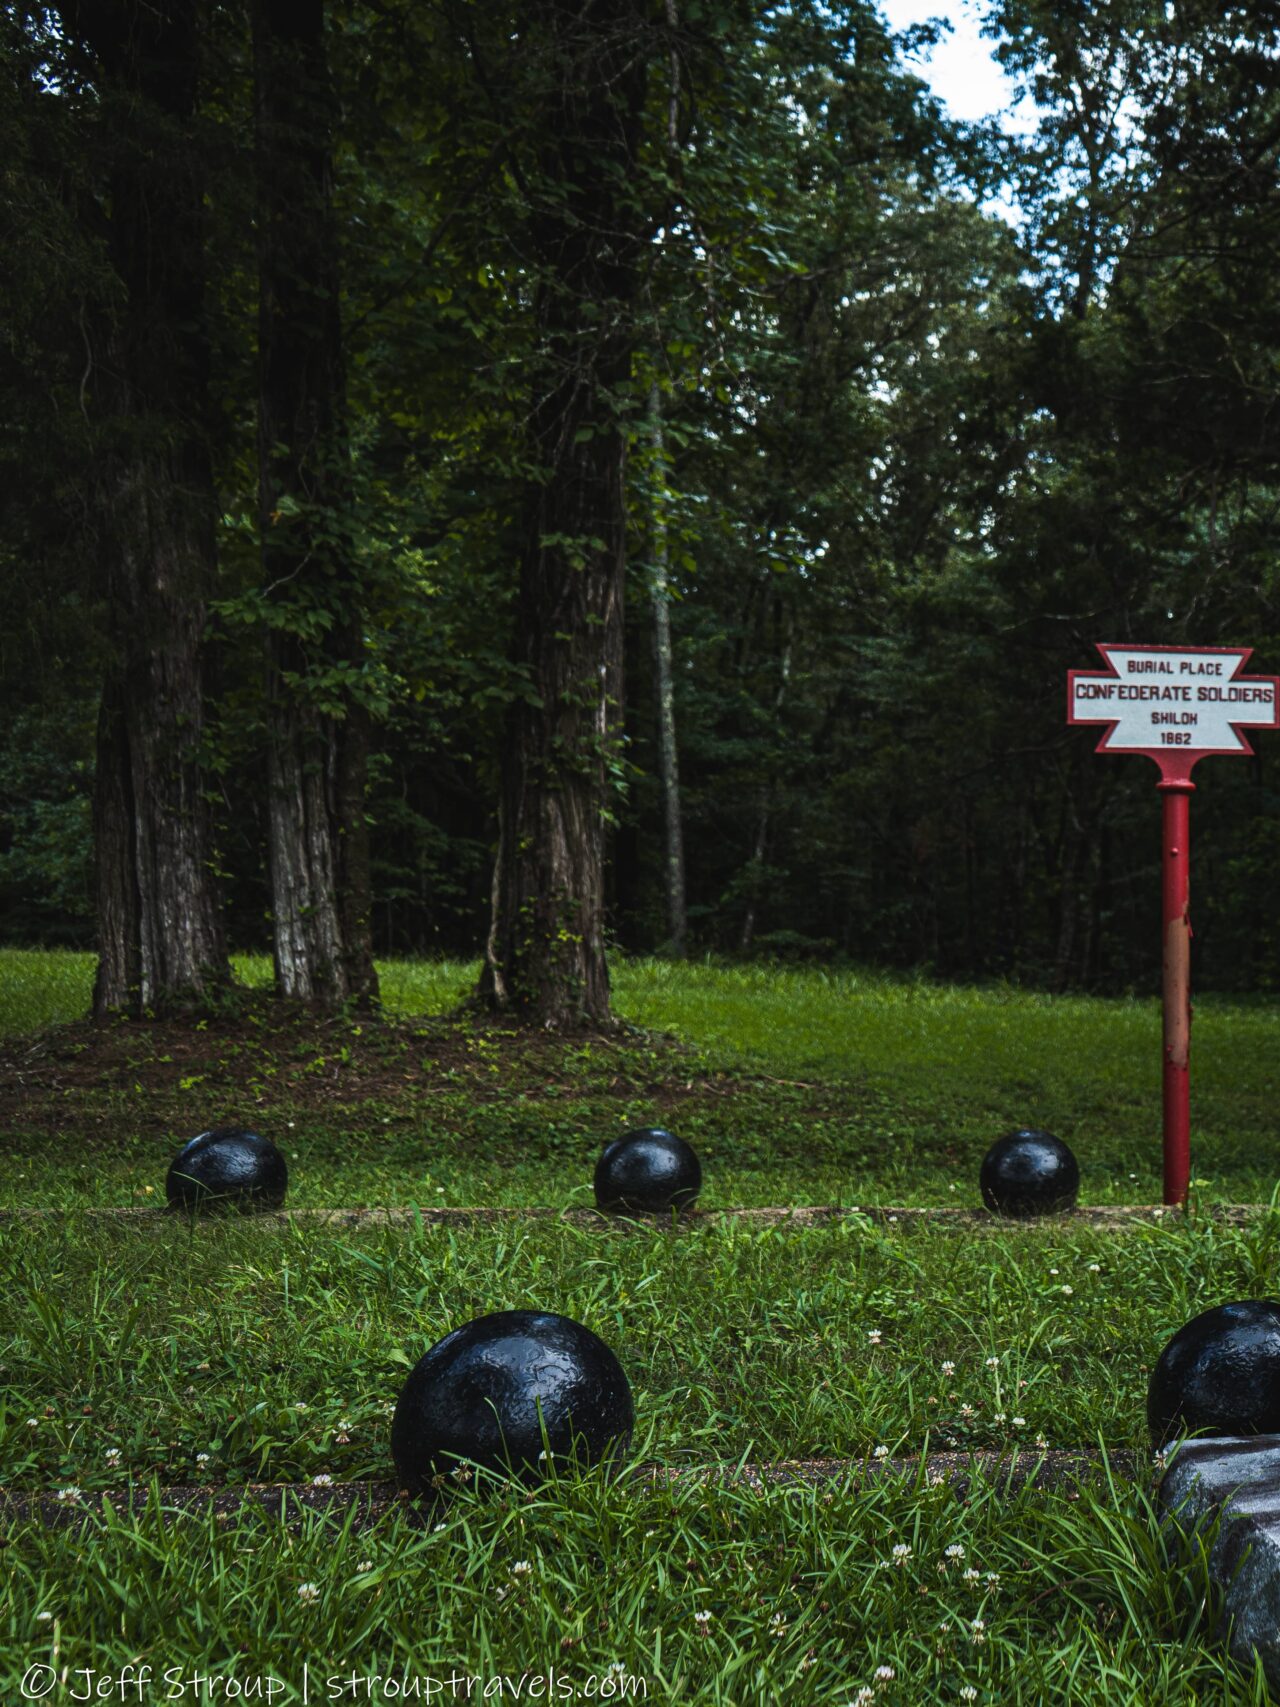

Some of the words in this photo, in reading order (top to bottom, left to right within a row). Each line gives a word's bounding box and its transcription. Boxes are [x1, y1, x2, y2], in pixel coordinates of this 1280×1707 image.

[1127, 660, 1174, 674] BURIAL
[1180, 662, 1223, 676] PLACE
[1075, 684, 1192, 701] CONFEDERATE
[1197, 687, 1273, 703] SOLDIERS
[1151, 711, 1198, 725] SHILOH
[1160, 733, 1191, 745] 1862
